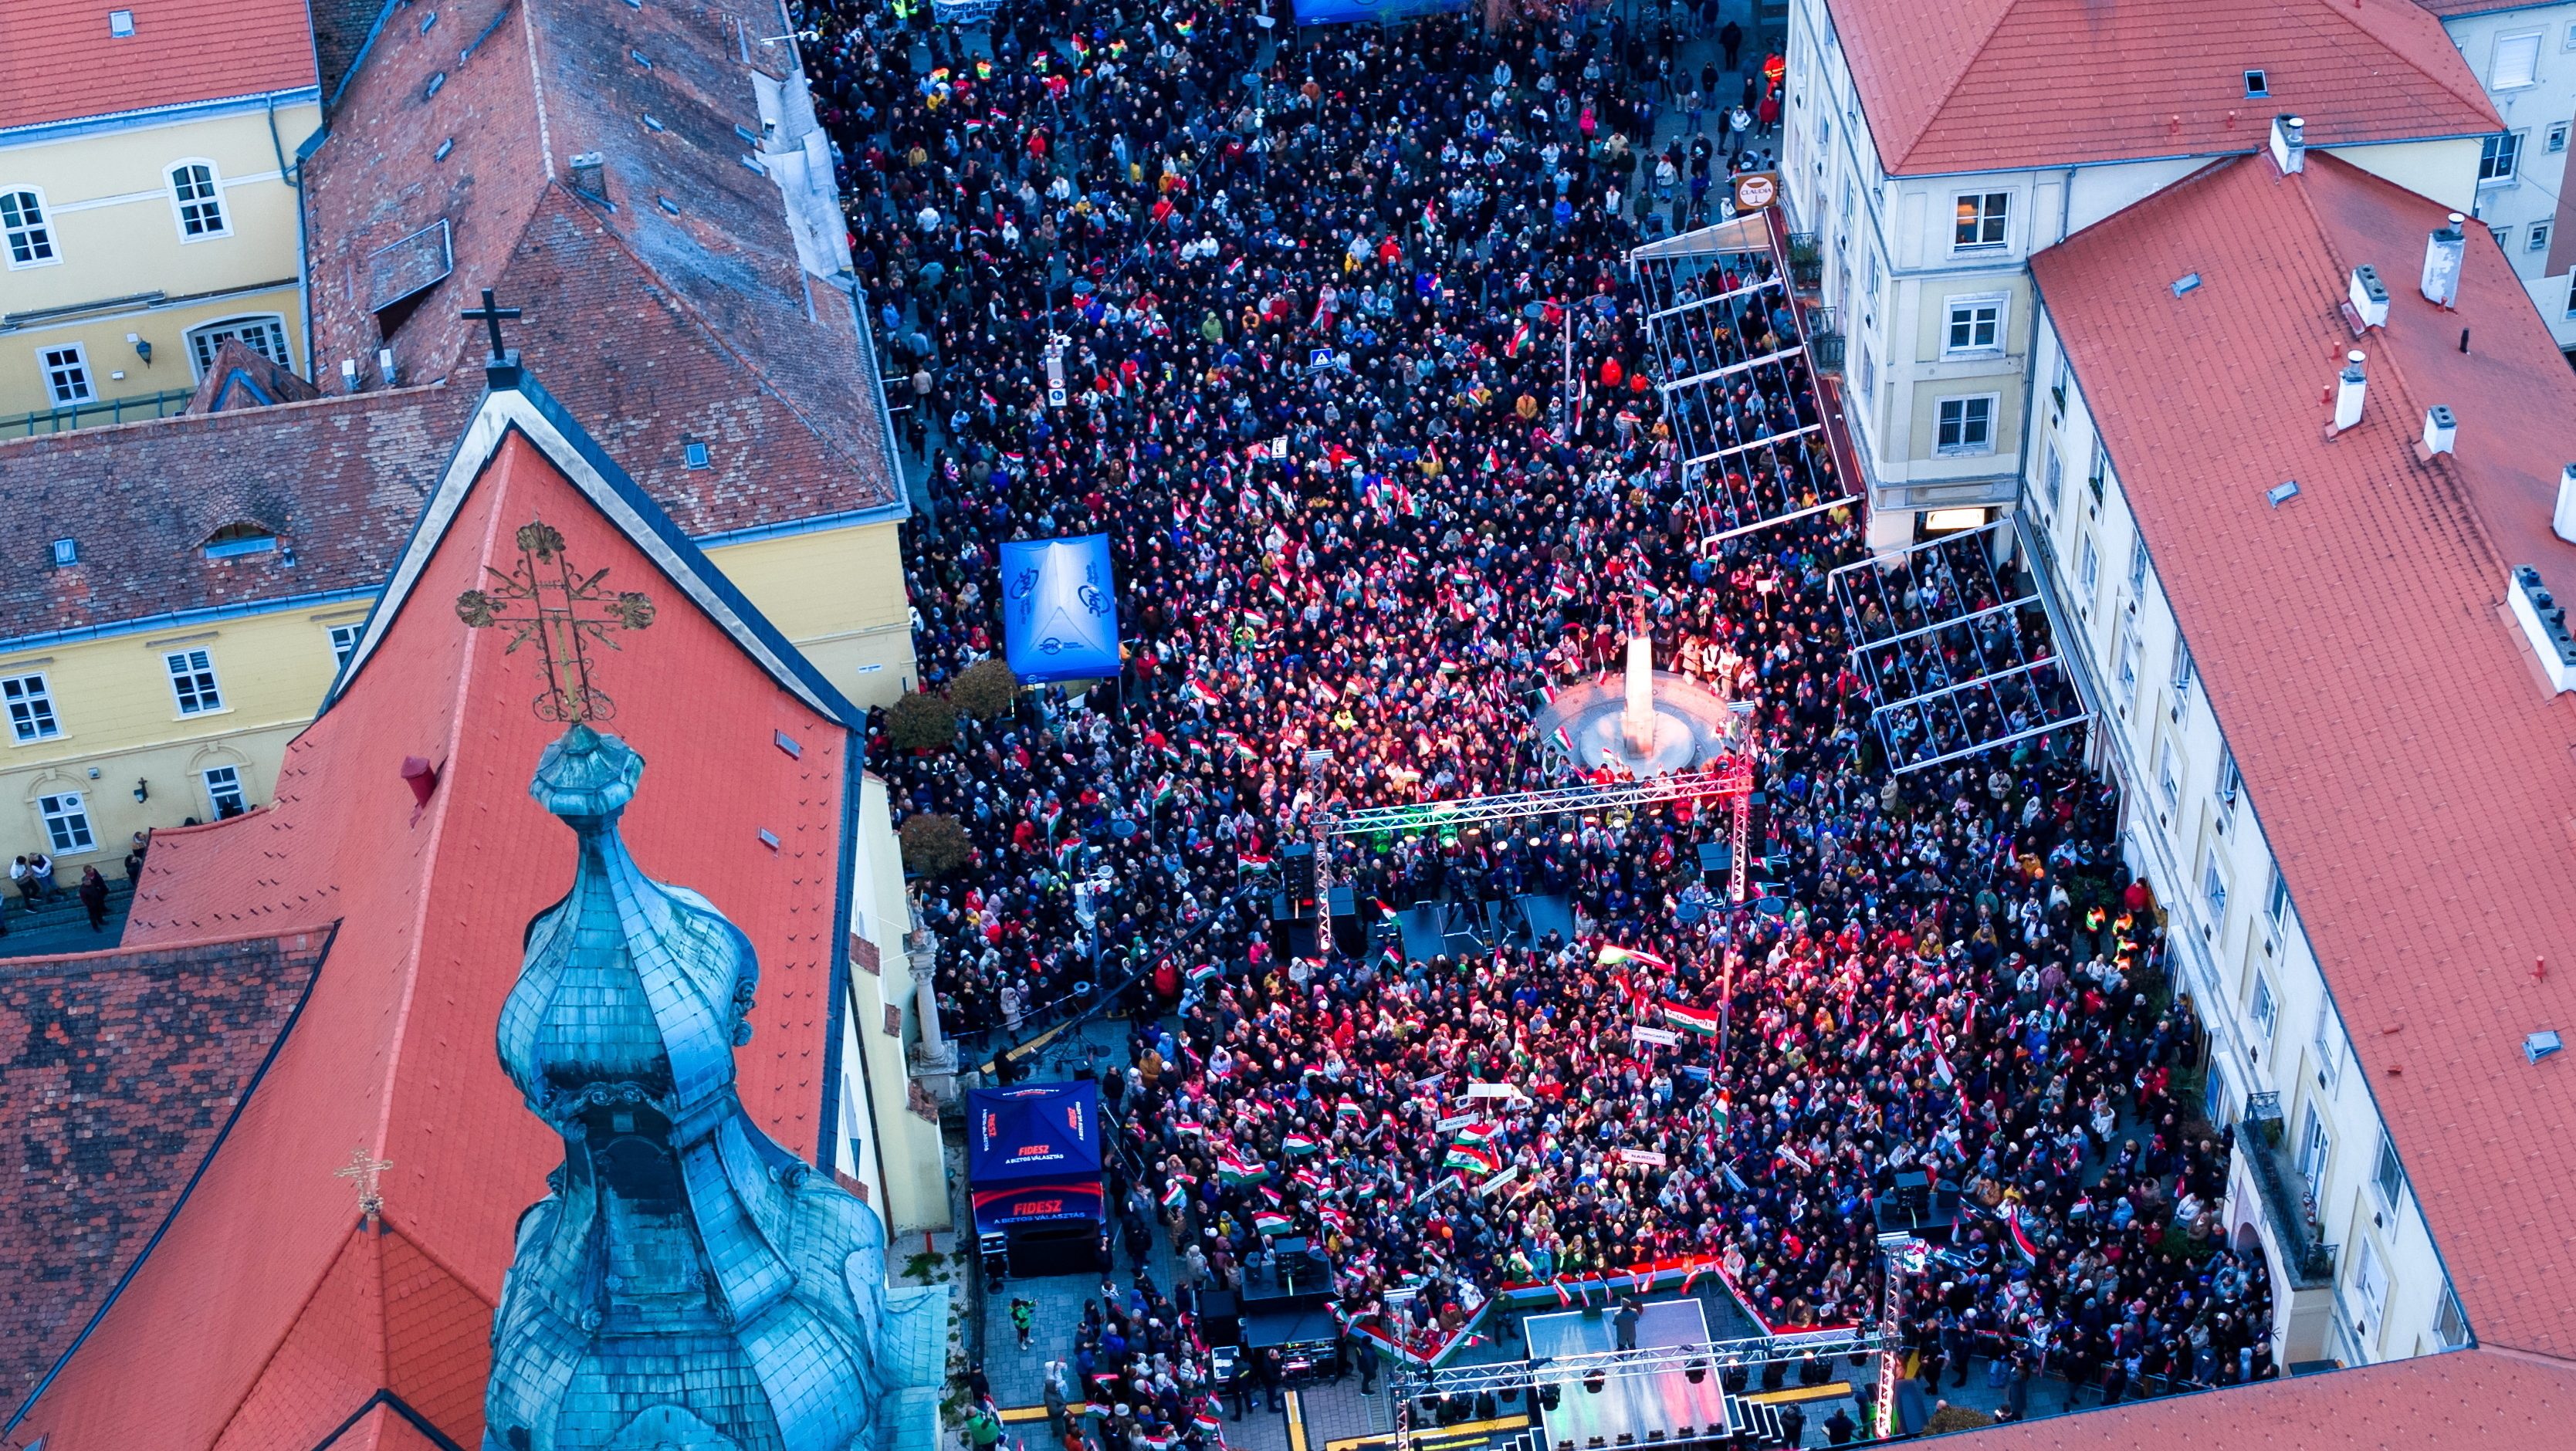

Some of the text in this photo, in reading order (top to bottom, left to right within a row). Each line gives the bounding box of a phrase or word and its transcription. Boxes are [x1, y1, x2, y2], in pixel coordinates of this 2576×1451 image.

[1445, 1118, 1469, 1127] BUCSU
[1018, 1145, 1049, 1156] FIDESZ
[1013, 1199, 1062, 1216] FIDESZ
[1034, 1211, 1085, 1221] VÁLASZTÁS
